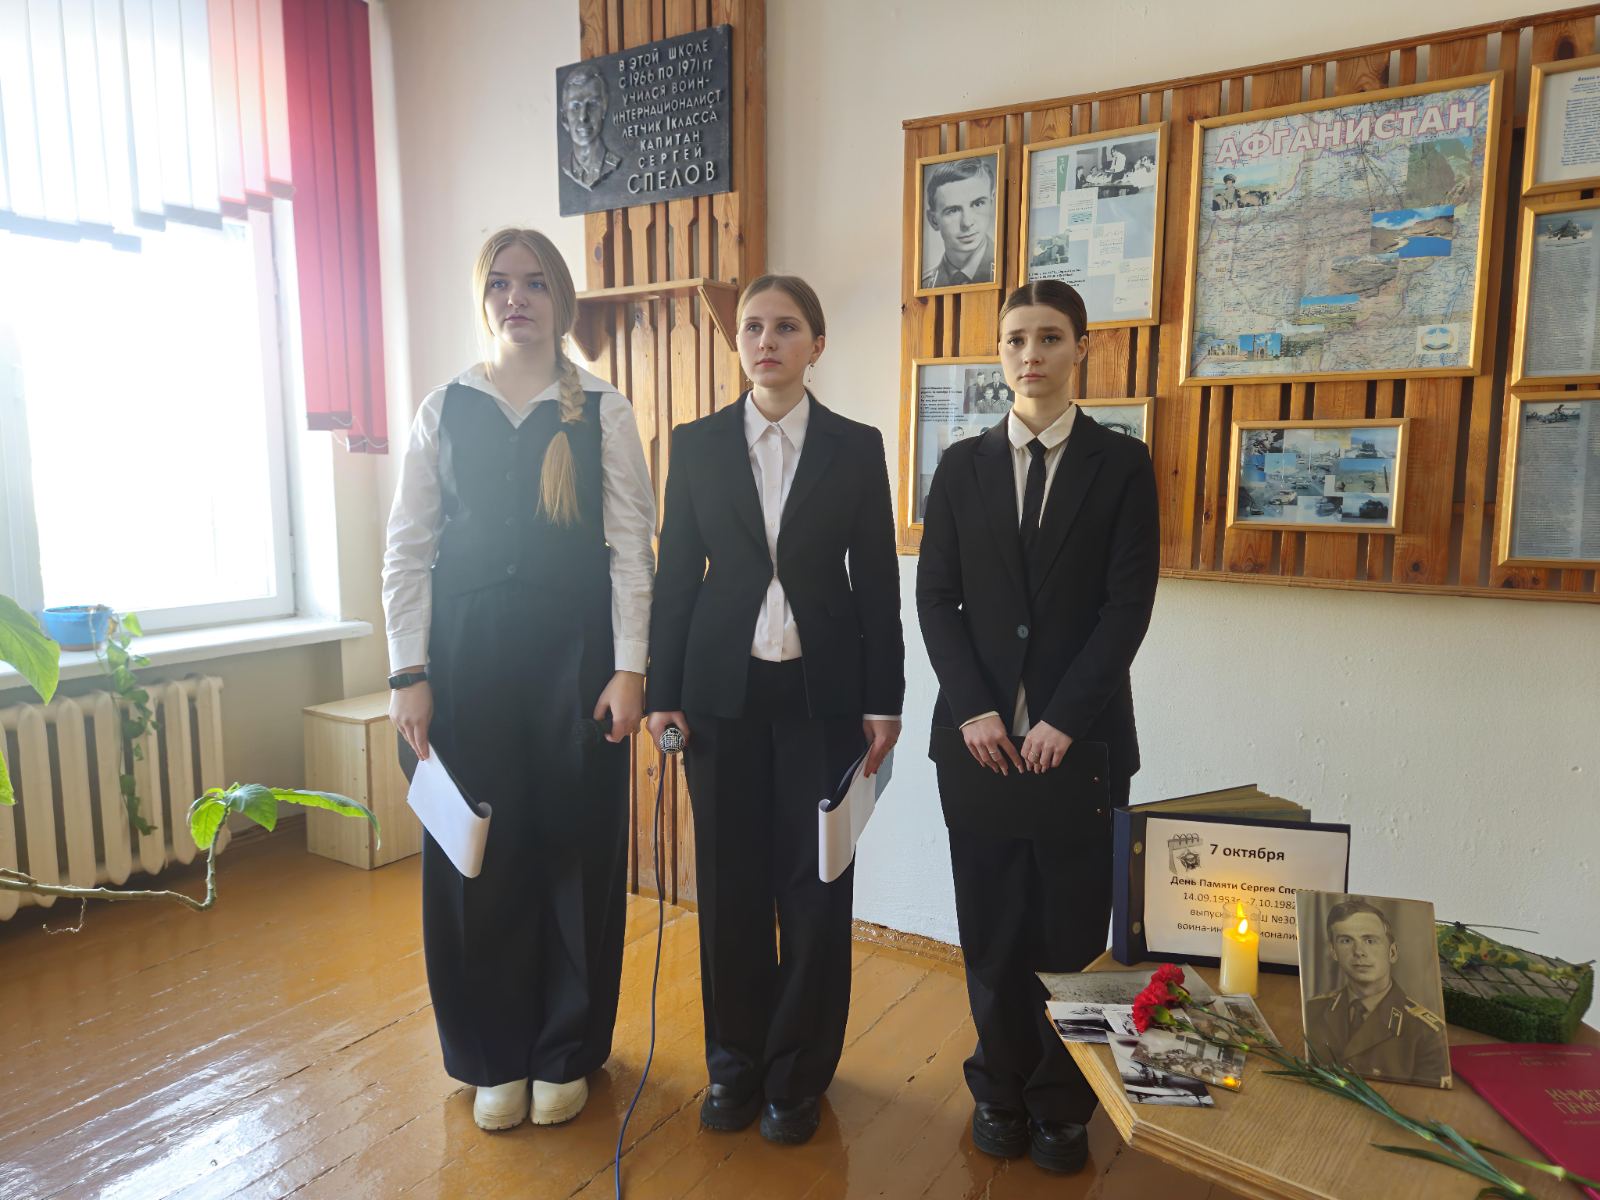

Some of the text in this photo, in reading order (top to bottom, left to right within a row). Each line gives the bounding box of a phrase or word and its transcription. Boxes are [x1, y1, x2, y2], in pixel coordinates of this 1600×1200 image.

[619, 39, 708, 72] В ЭТОЙ ШКОЛЕ
[619, 77, 627, 90] С
[629, 71, 655, 87] 1966
[658, 65, 674, 80] ПО
[678, 60, 700, 77] 1971
[622, 77, 710, 106] УЧИЛСЯ ВОИН-
[612, 89, 720, 125] ИНТЕРНАЦИОНАЛИСТ
[622, 120, 661, 138] ЛЕТЧИК
[640, 130, 700, 151] КАПИТАН
[1215, 102, 1476, 163] АФГАНИСТАН
[638, 143, 702, 169] СЕРГЕЙ
[627, 160, 715, 194] СПЕЛОВ
[1209, 843, 1286, 862] 7 октября
[1170, 876, 1197, 886] День
[1199, 878, 1238, 890] Памяти
[1240, 882, 1275, 893] Сергея
